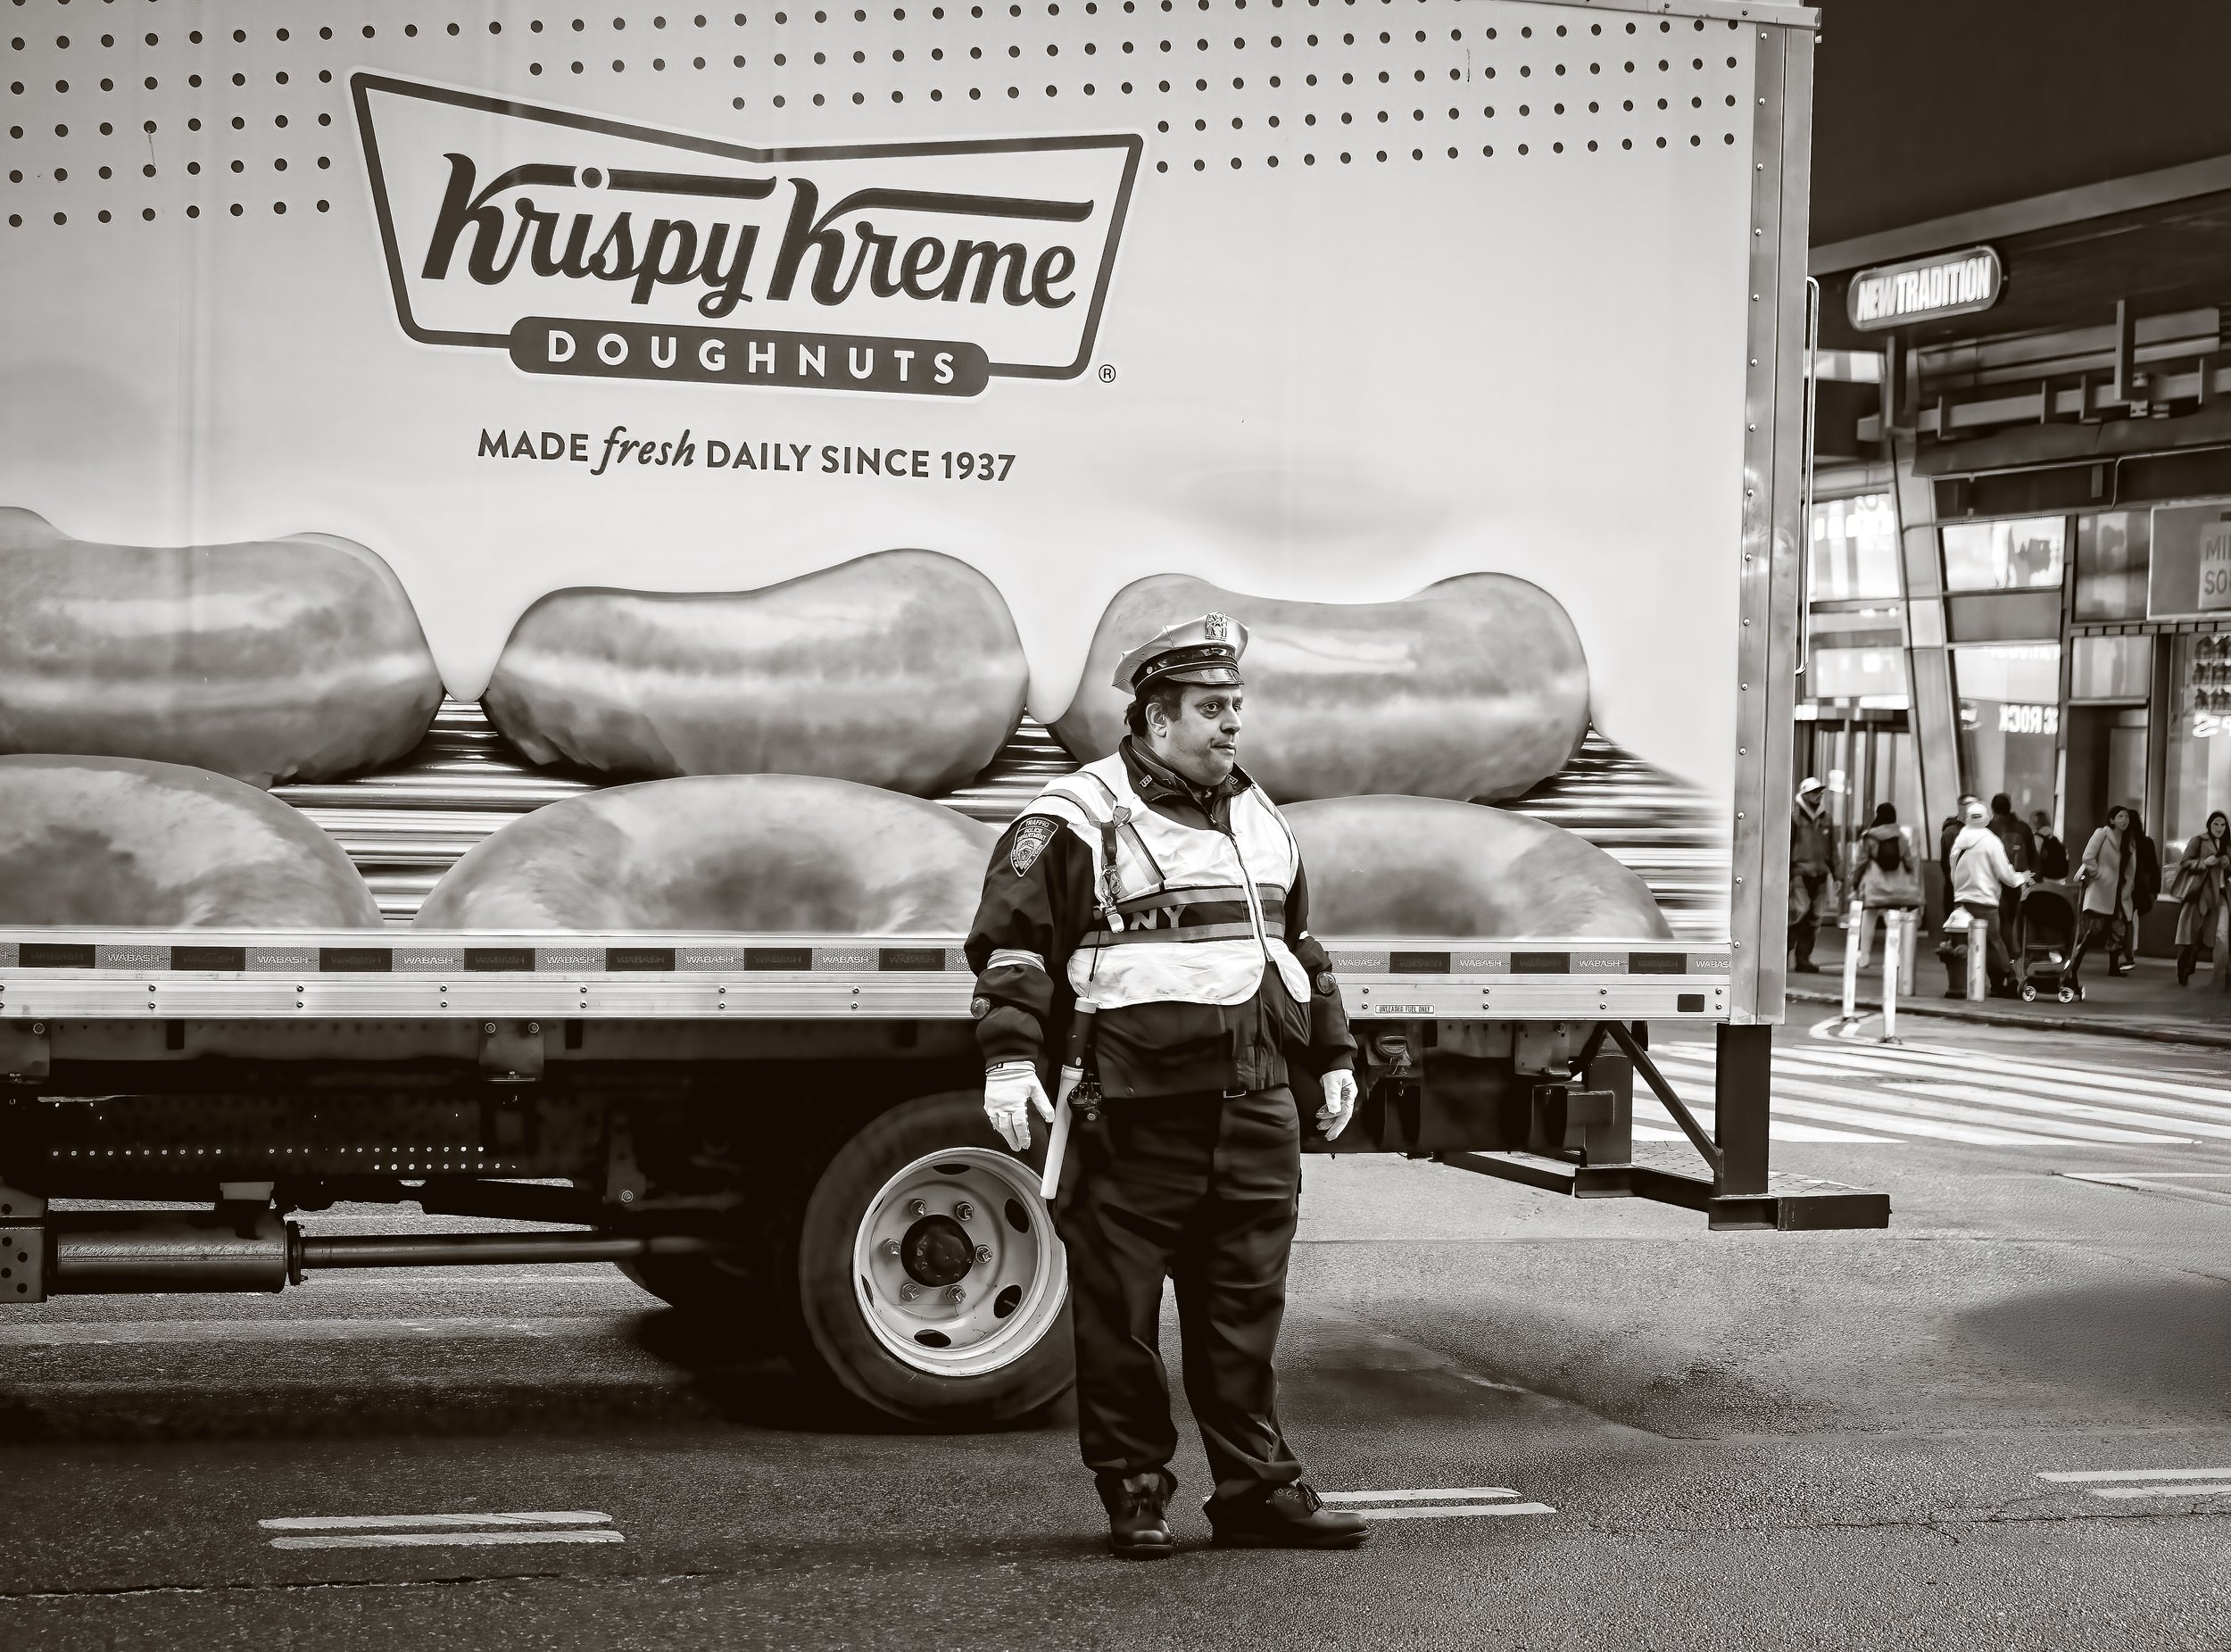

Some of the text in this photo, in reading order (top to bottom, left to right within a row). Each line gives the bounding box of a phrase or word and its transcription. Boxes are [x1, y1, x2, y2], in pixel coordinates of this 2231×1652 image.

[548, 329, 955, 385] DOUGHNUTS
[478, 426, 1016, 482] MADE fresh DAILY SINCE 1937
[2205, 535, 2231, 561] MI
[2204, 569, 2231, 595] SO
[1025, 818, 1049, 828] TRAFFIC
[1129, 904, 1187, 931] NY
[108, 952, 160, 963] WABASH
[257, 955, 309, 964] WABASH
[404, 955, 453, 965] WABASH
[547, 955, 595, 964] WABASH
[686, 955, 734, 964] WABASH
[822, 955, 868, 964] WABASH
[1339, 958, 1381, 967] WABASH
[1460, 959, 1502, 967] WABASH
[1580, 959, 1620, 967] WABASH
